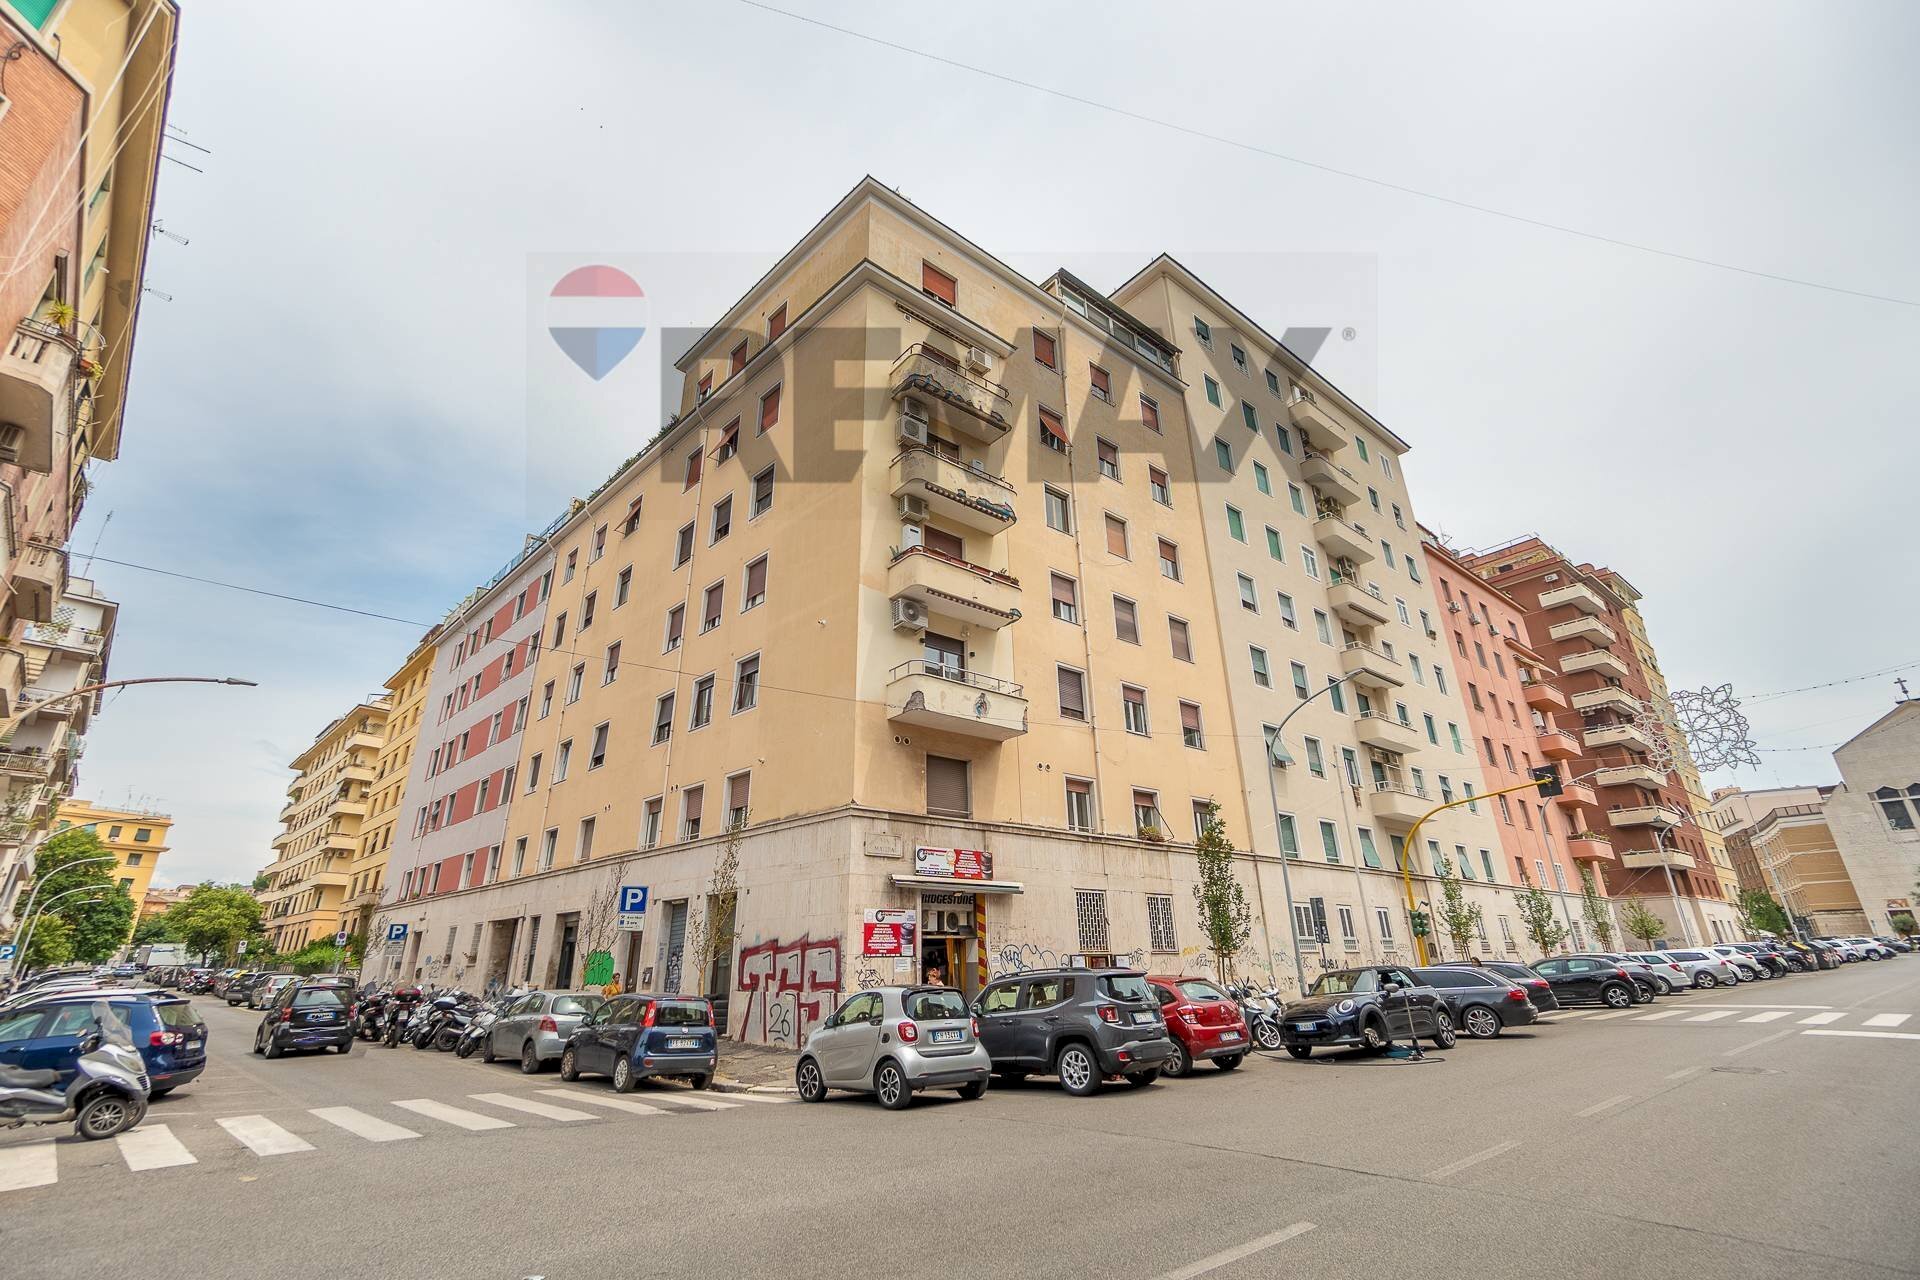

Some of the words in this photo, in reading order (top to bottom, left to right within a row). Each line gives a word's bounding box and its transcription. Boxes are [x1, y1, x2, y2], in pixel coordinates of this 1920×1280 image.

[625, 888, 644, 911] P
[921, 893, 976, 904] RIDGESTONE
[391, 925, 404, 939] P
[768, 1003, 791, 1037] 26
